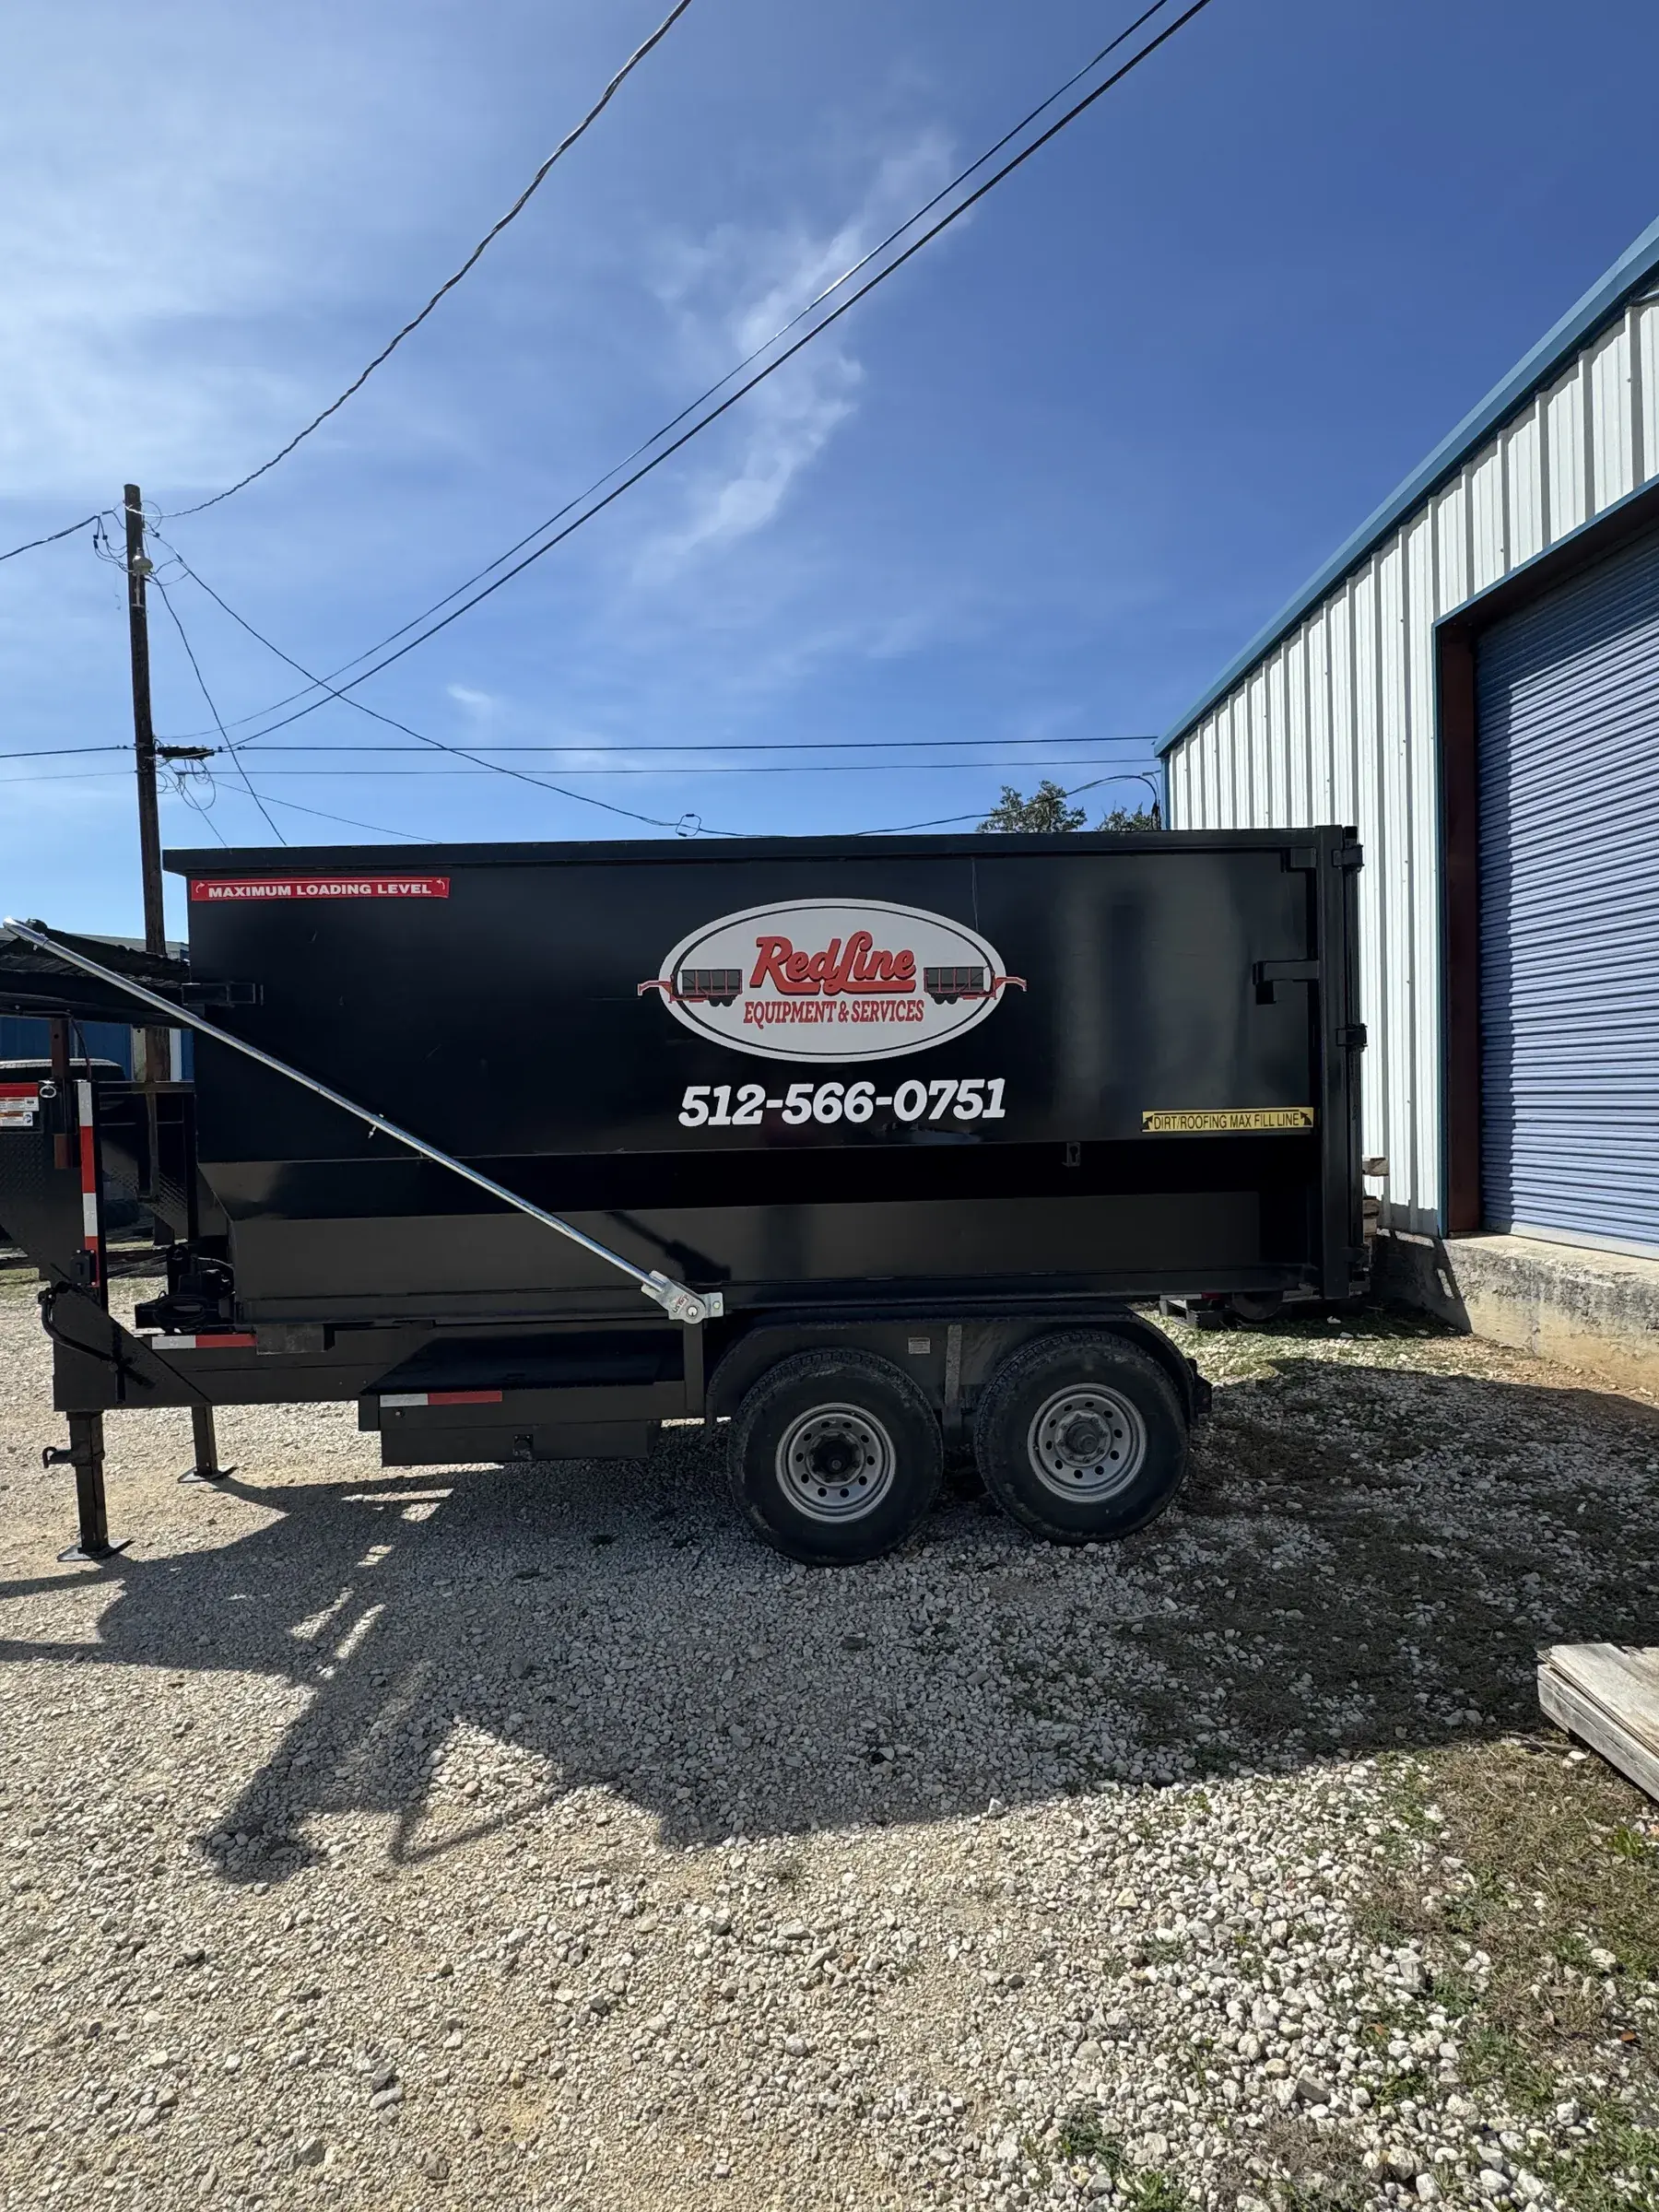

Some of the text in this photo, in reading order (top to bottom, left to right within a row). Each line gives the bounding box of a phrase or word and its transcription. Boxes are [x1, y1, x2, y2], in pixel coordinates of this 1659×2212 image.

[208, 884, 431, 898] MAXIMUM LOADING LEVEL
[749, 930, 916, 996] RedLine
[743, 999, 924, 1030] EQUIPMENT & SERVICES
[678, 1077, 1006, 1128] 512-566-0751
[1230, 1114, 1253, 1128] MAX
[1253, 1113, 1275, 1127] FILL
[1277, 1112, 1299, 1126] LINE
